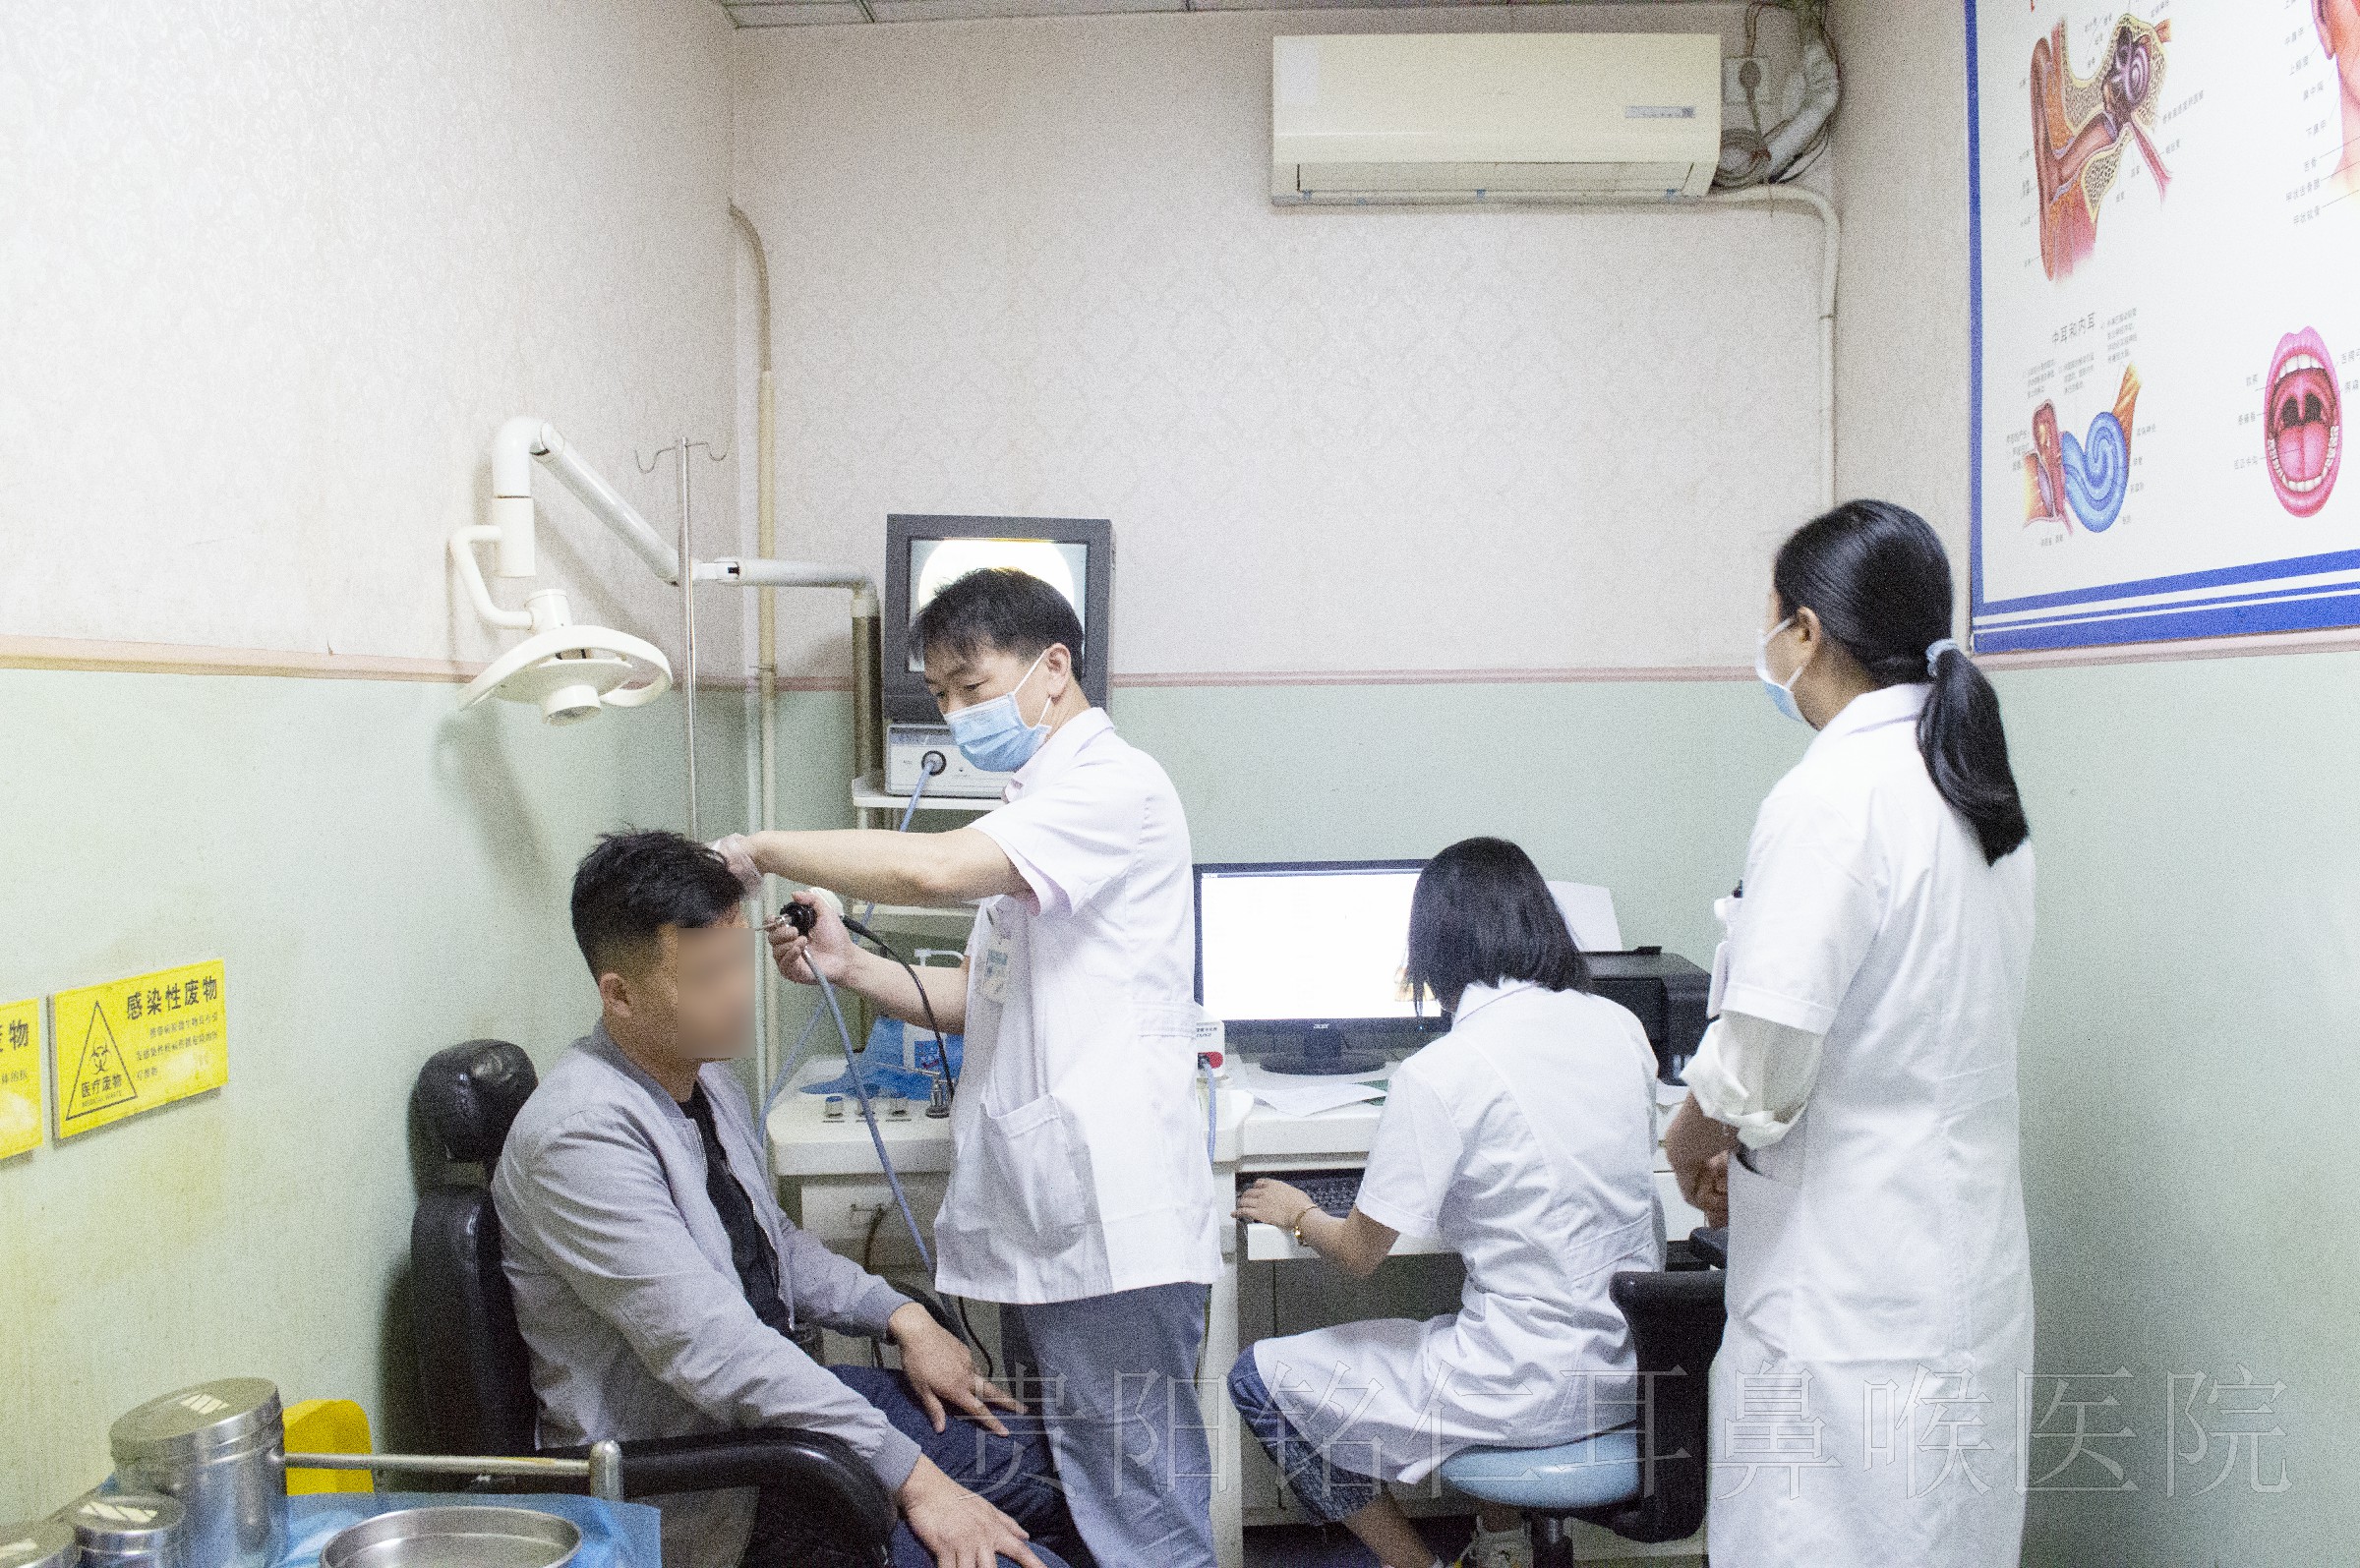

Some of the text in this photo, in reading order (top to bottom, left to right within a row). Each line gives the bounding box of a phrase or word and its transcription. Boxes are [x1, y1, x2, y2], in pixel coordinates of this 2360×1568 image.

[127, 975, 217, 1020] 感染性废物
[81, 1074, 122, 1099] 医疗废物
